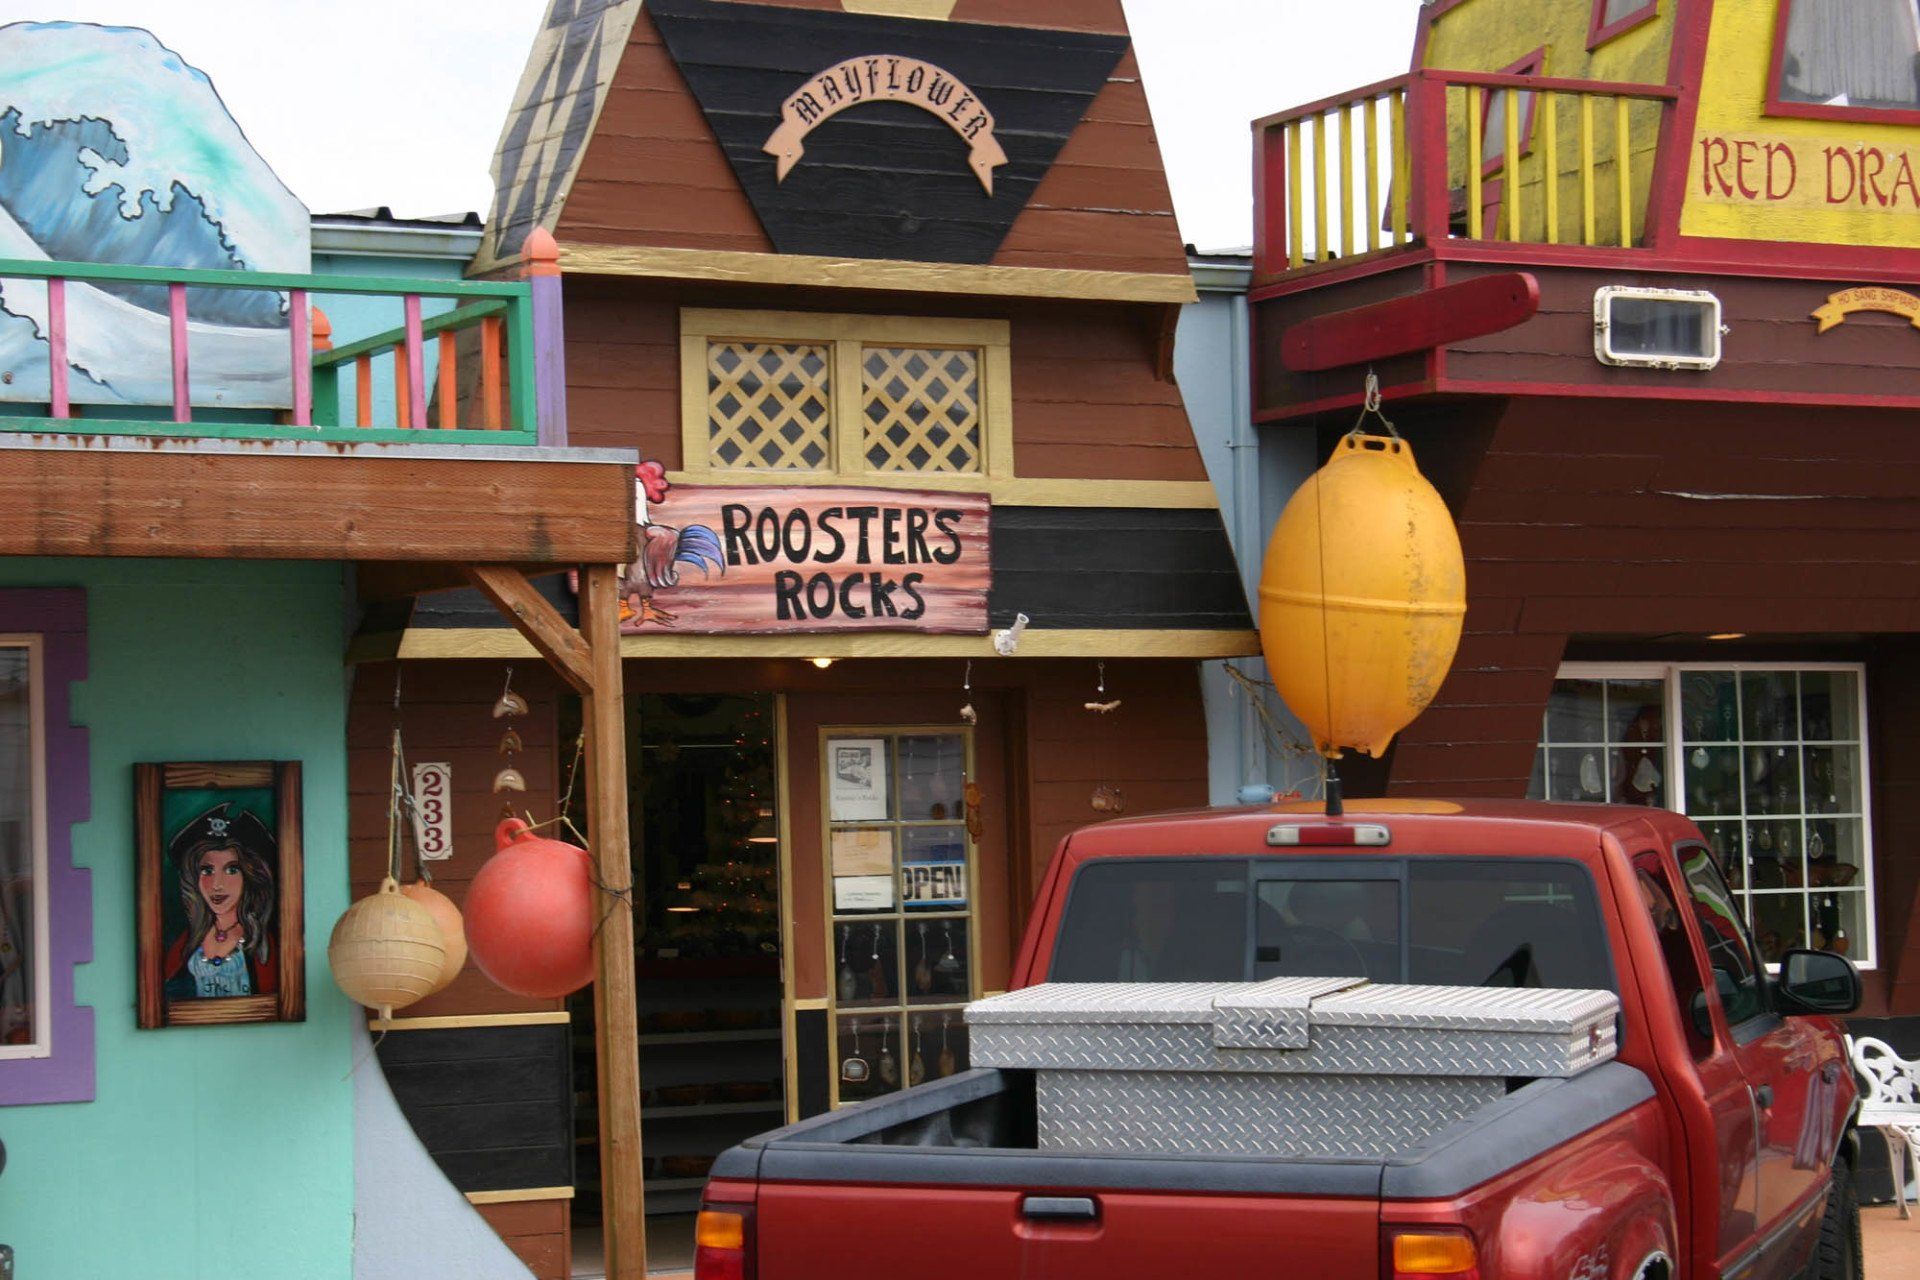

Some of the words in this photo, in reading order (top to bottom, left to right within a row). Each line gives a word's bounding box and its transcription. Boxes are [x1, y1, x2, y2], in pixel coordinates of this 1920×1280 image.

[789, 58, 988, 141] MAYFLOWER
[1699, 136, 1797, 201] RED
[1823, 146, 1920, 209] DRA
[775, 569, 926, 621] ROCKS
[422, 771, 444, 853] 233
[902, 866, 962, 901] OPEN
